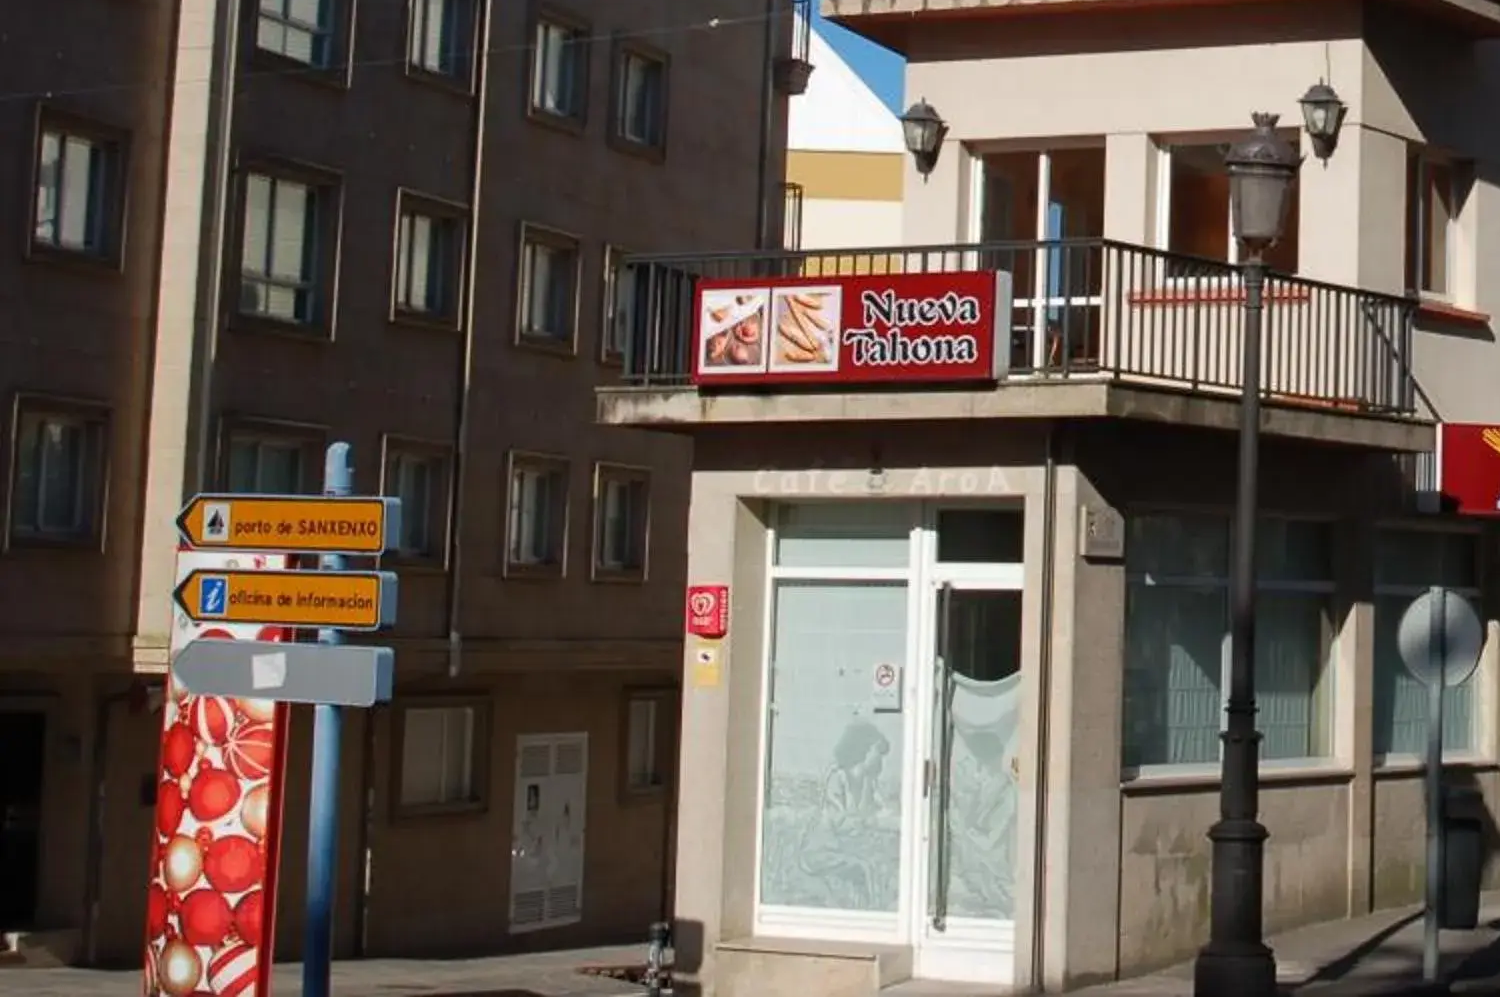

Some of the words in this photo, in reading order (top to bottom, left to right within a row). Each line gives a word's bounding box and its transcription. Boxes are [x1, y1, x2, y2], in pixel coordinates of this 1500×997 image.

[861, 289, 981, 327] Nueva
[844, 326, 978, 366] Tahona
[234, 519, 272, 536] porto
[276, 519, 293, 535] de
[298, 519, 378, 537] SANXENXO
[229, 590, 273, 605] oficina
[277, 592, 293, 607] de
